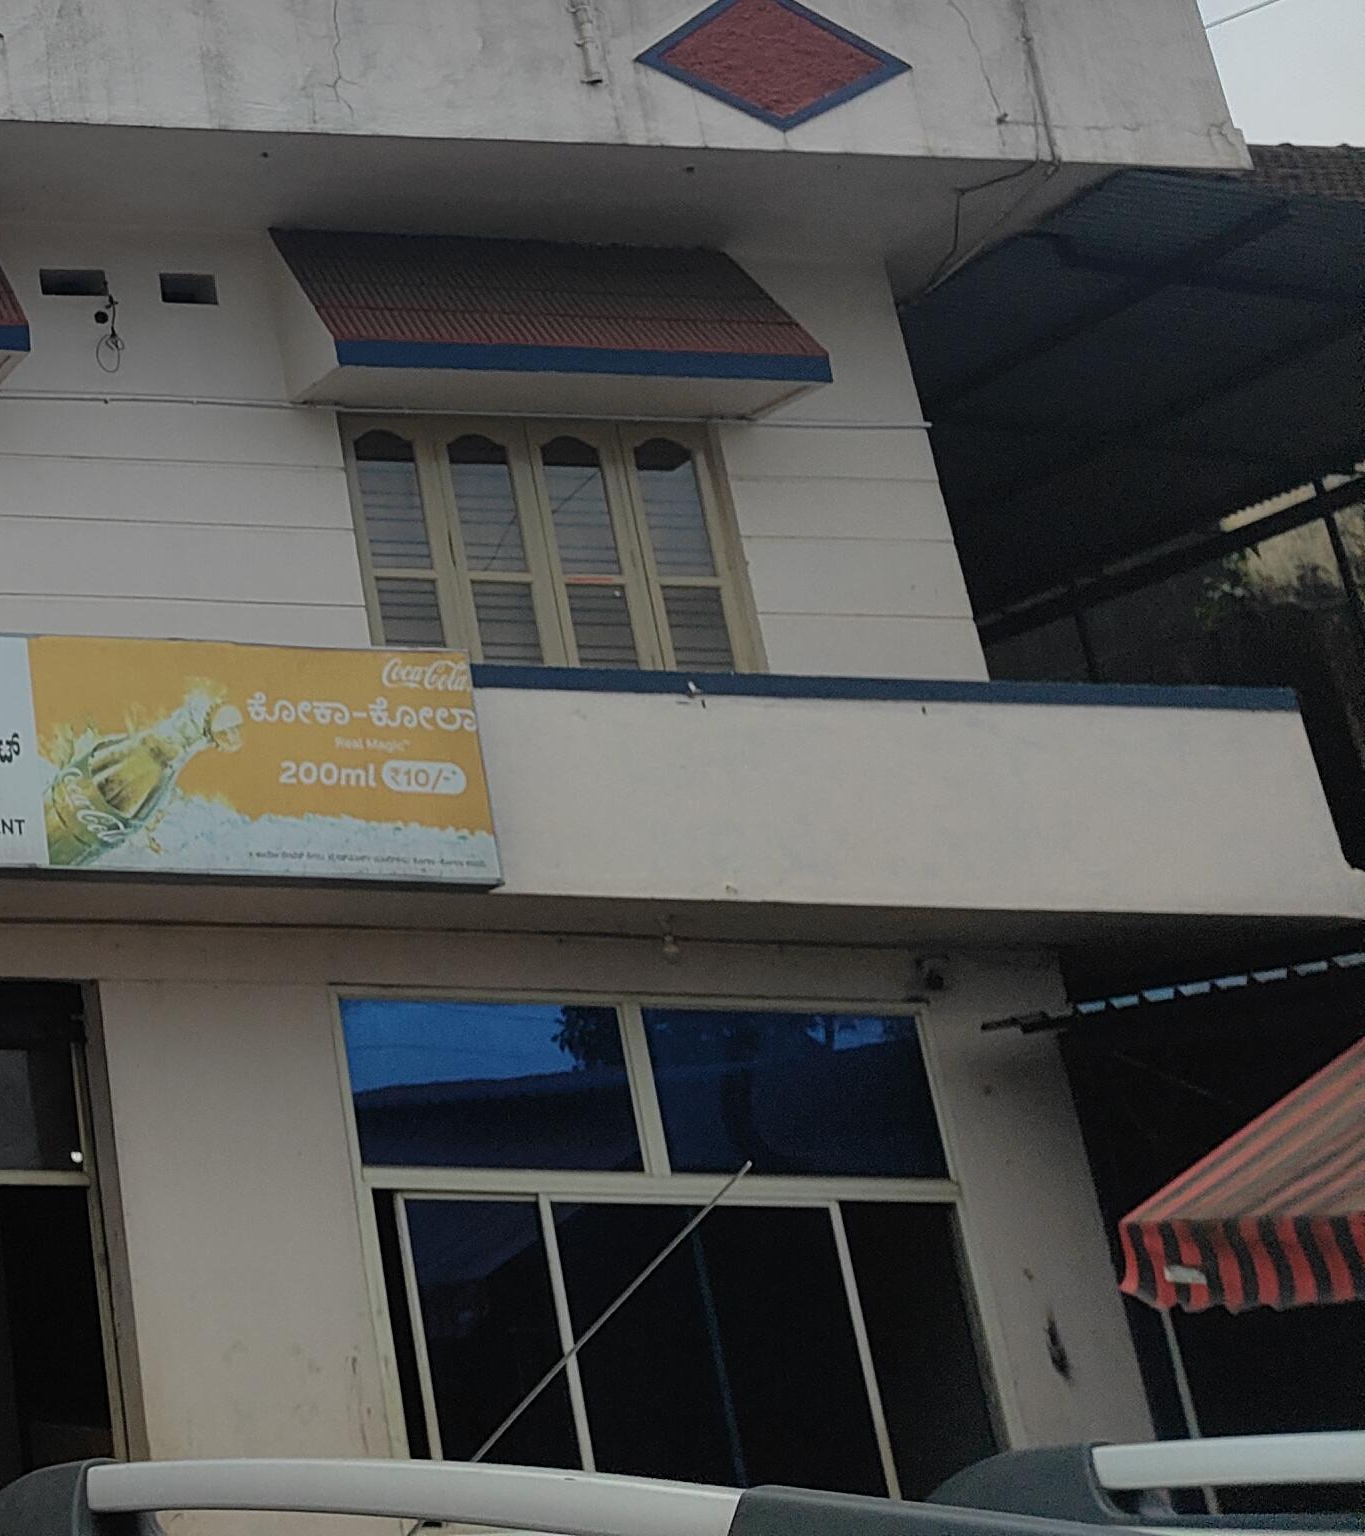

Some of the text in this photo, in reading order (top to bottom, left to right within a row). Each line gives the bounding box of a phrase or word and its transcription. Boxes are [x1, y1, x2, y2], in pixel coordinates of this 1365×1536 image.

[381, 657, 471, 692] Coca-Cola
[334, 735, 364, 750] Real
[278, 760, 377, 788] 200ml
